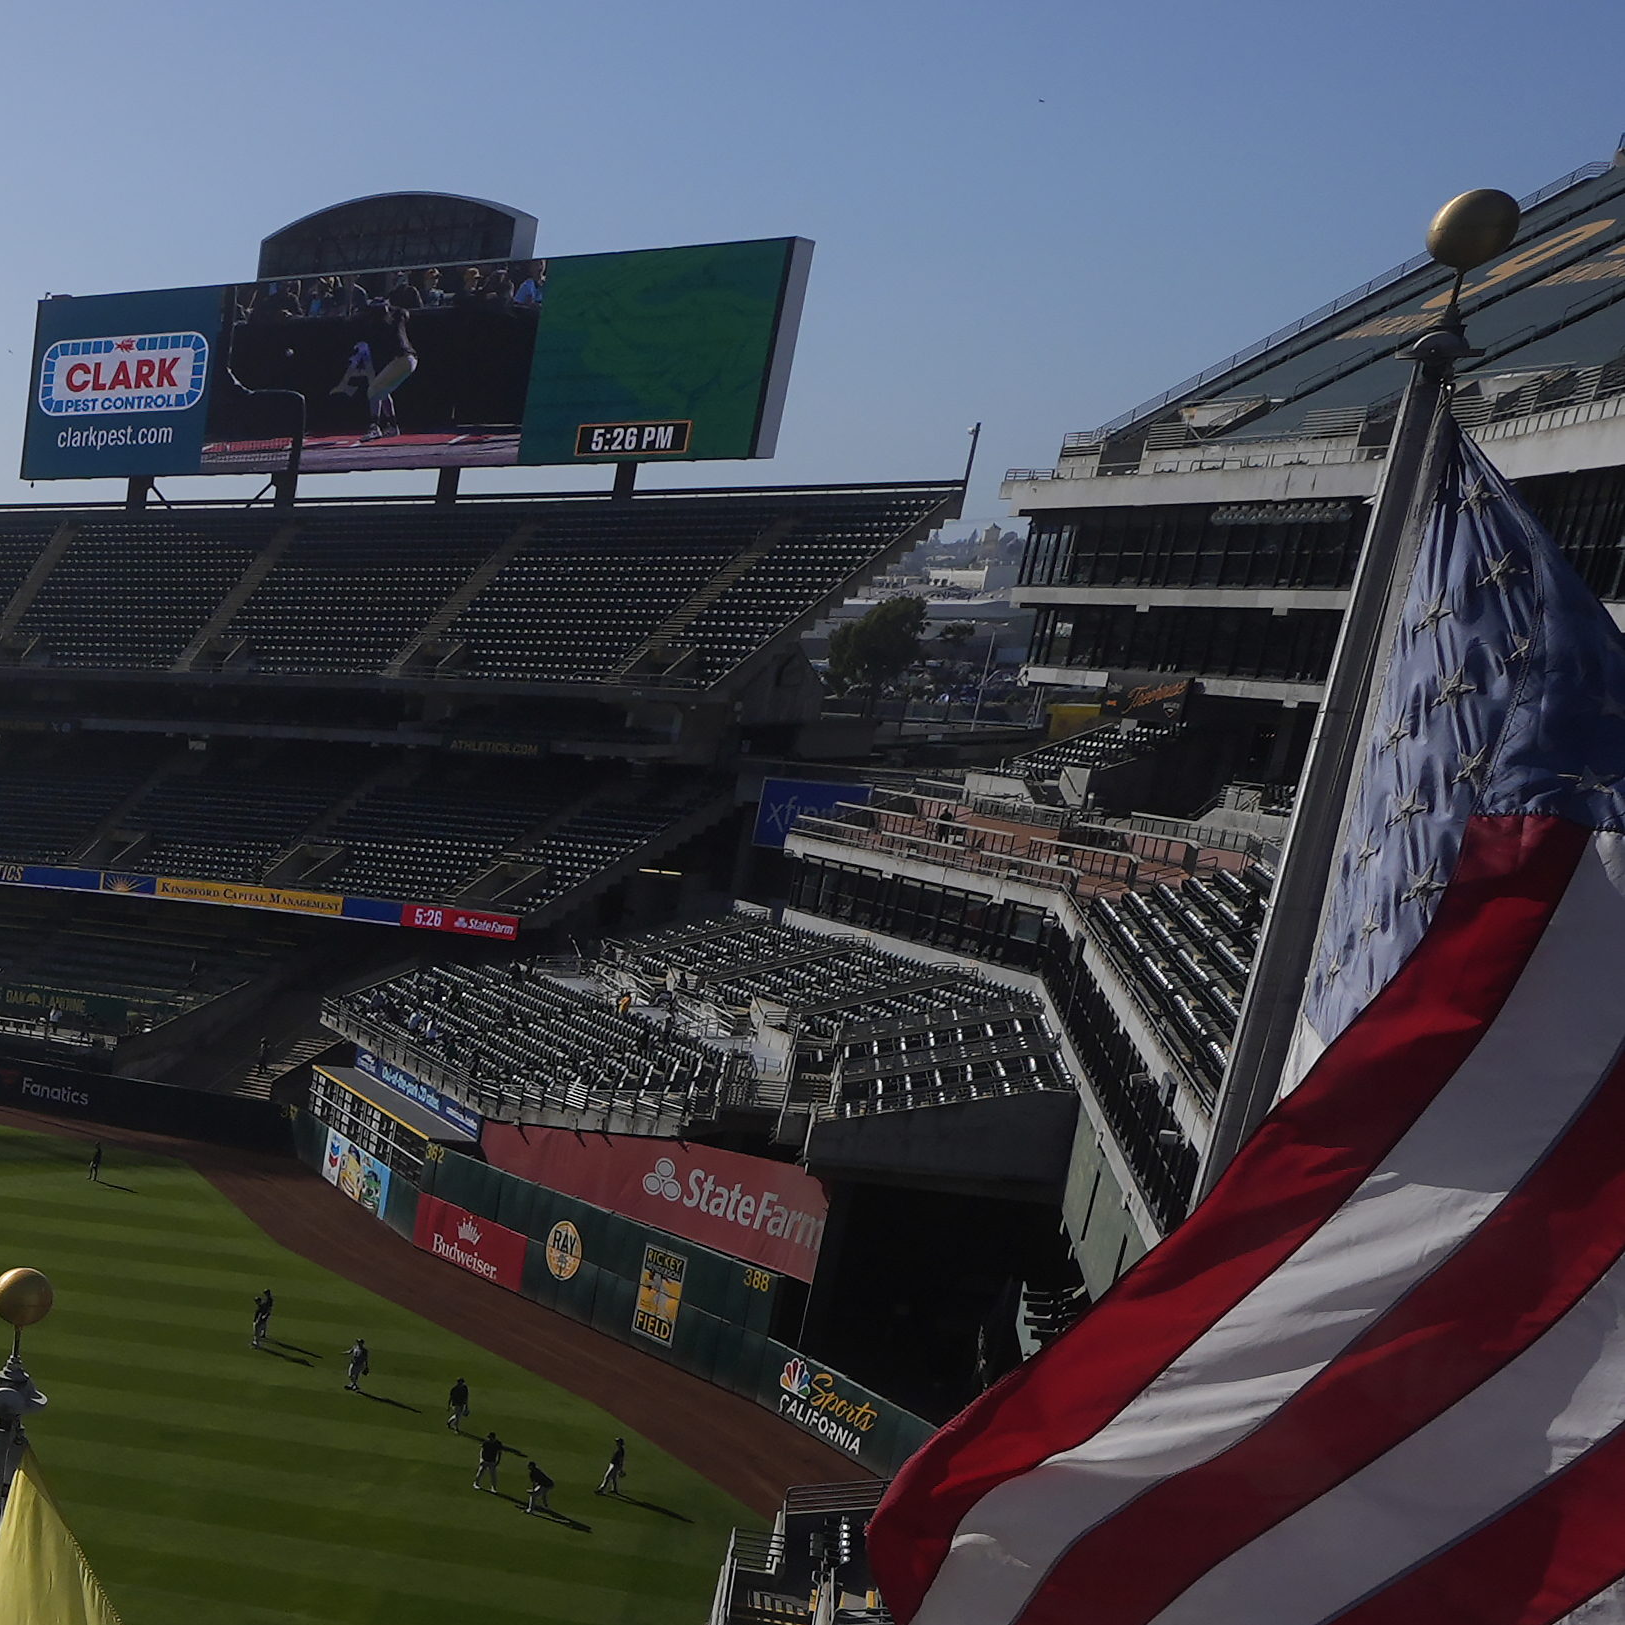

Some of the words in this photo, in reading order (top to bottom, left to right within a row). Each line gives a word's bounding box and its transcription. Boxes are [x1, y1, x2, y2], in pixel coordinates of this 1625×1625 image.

[65, 356, 181, 393] CLARK
[64, 397, 99, 413] PEST
[100, 393, 175, 411] CONTROL
[57, 425, 174, 452] clarkpest.com
[591, 426, 639, 452] 5:26
[641, 425, 675, 451] PM
[450, 739, 539, 755] ATHLETICS.COM
[160, 881, 220, 898] KINGSFORD
[222, 887, 267, 903] CAPITAL
[269, 892, 341, 912] MANAGEMENT
[413, 907, 443, 928] 5:26
[21, 1076, 90, 1106] Fanatics
[432, 1232, 498, 1280] Budweiser
[552, 1229, 577, 1256] RAY
[646, 1248, 683, 1271] RICKEY
[743, 1268, 770, 1293] 388
[636, 1311, 670, 1340] FIELD
[810, 1372, 879, 1432] Sports
[778, 1393, 861, 1456] CALIFORNIA
